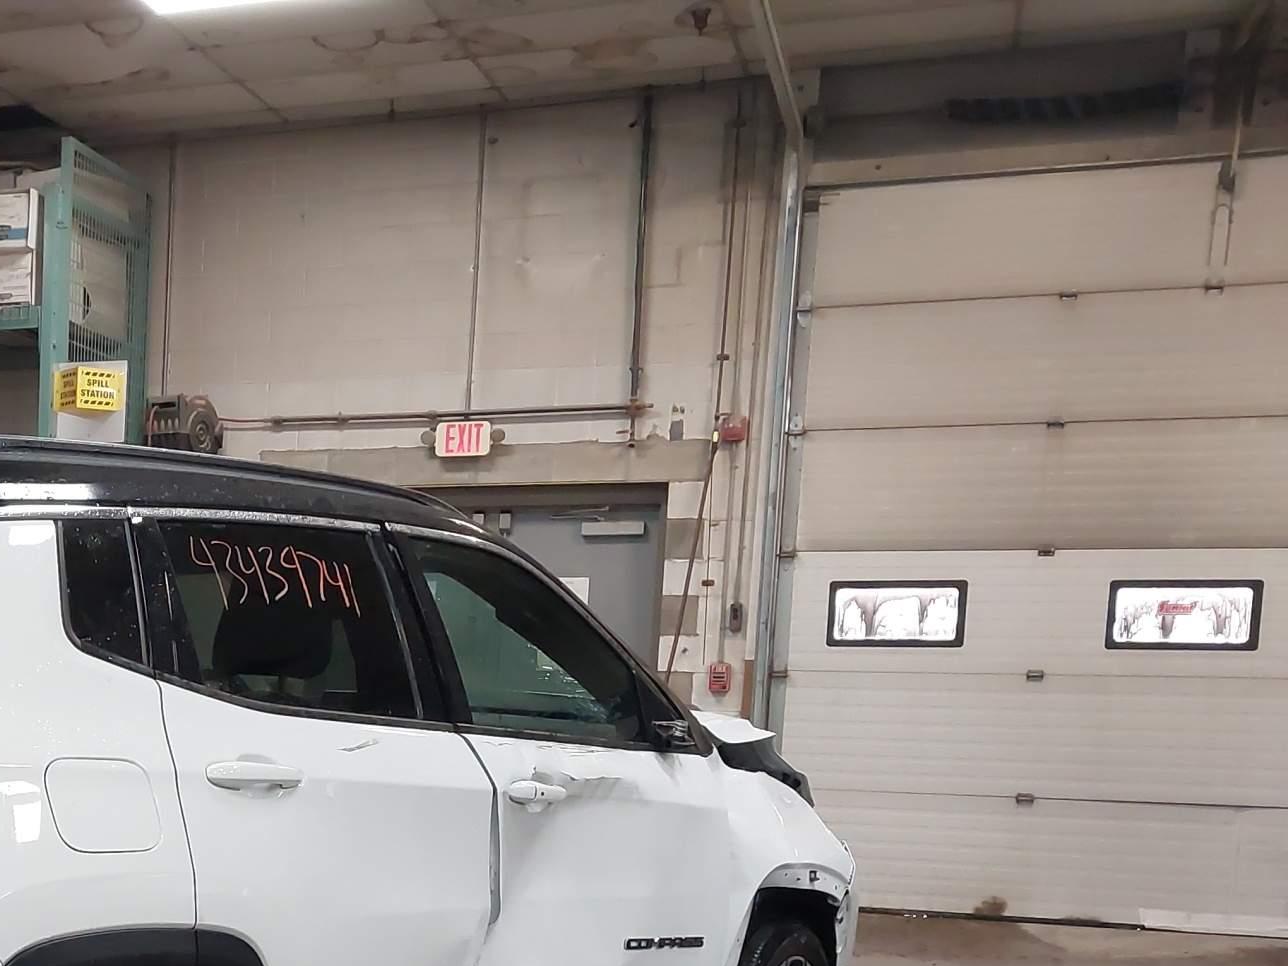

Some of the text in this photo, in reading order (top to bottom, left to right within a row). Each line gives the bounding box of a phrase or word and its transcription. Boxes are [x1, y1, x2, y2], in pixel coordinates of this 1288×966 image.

[86, 378, 110, 388] SPILL
[80, 388, 115, 399] STATION
[445, 423, 484, 453] EXIT
[190, 536, 361, 618] 43439741
[624, 936, 705, 951] COMPASS
